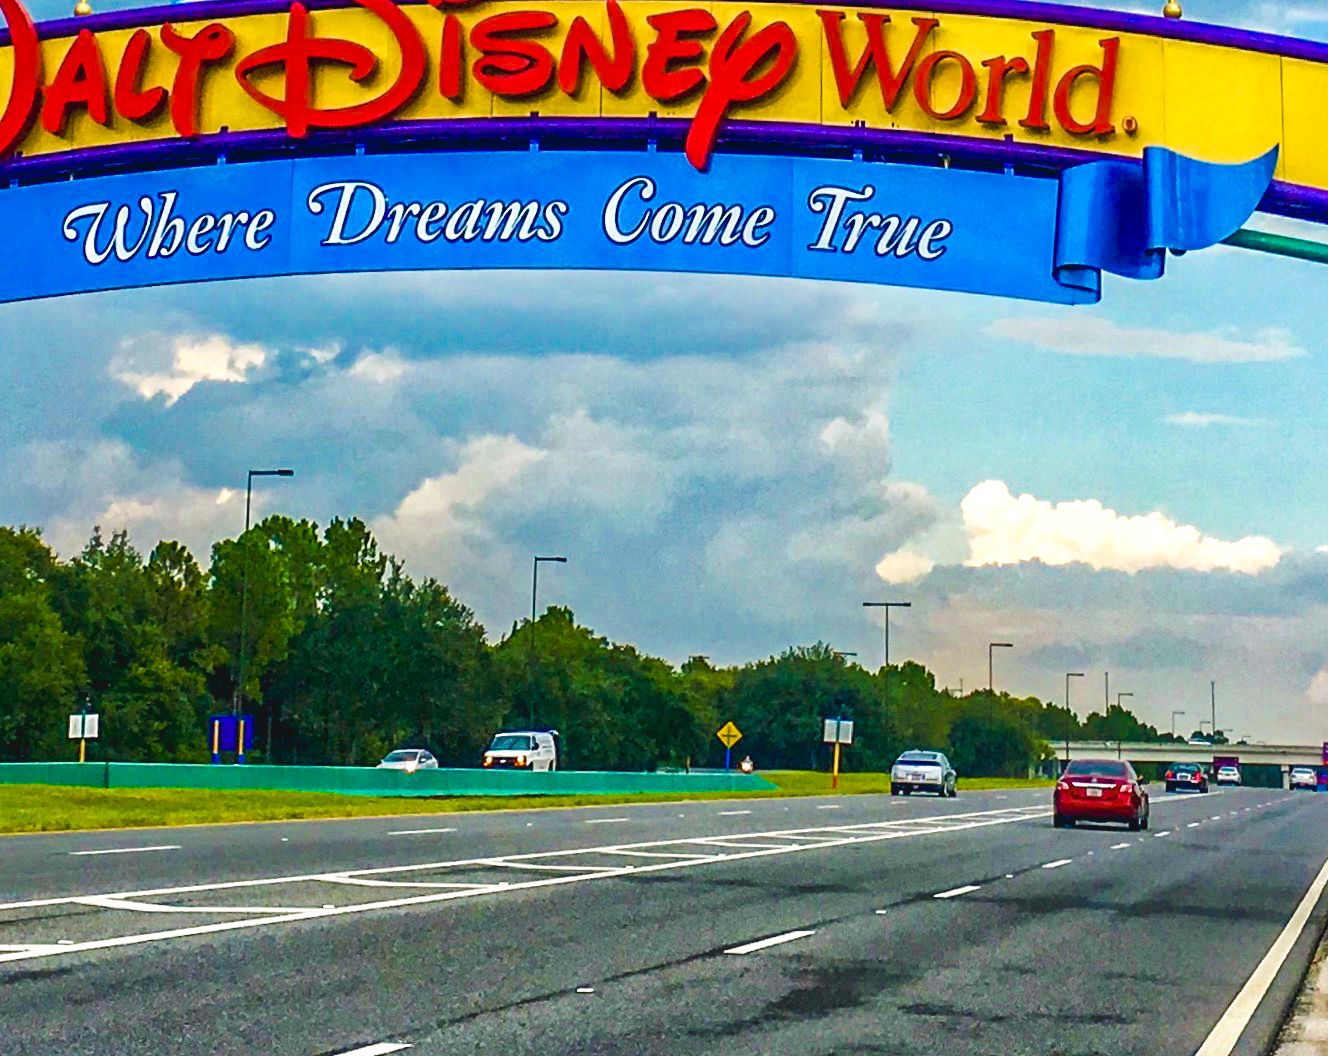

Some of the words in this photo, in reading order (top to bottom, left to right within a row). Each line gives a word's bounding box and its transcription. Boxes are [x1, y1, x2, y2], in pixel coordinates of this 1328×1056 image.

[63, 190, 274, 264] Where
[308, 181, 568, 246] Dreams
[603, 176, 775, 246] Come
[808, 184, 952, 261] True
